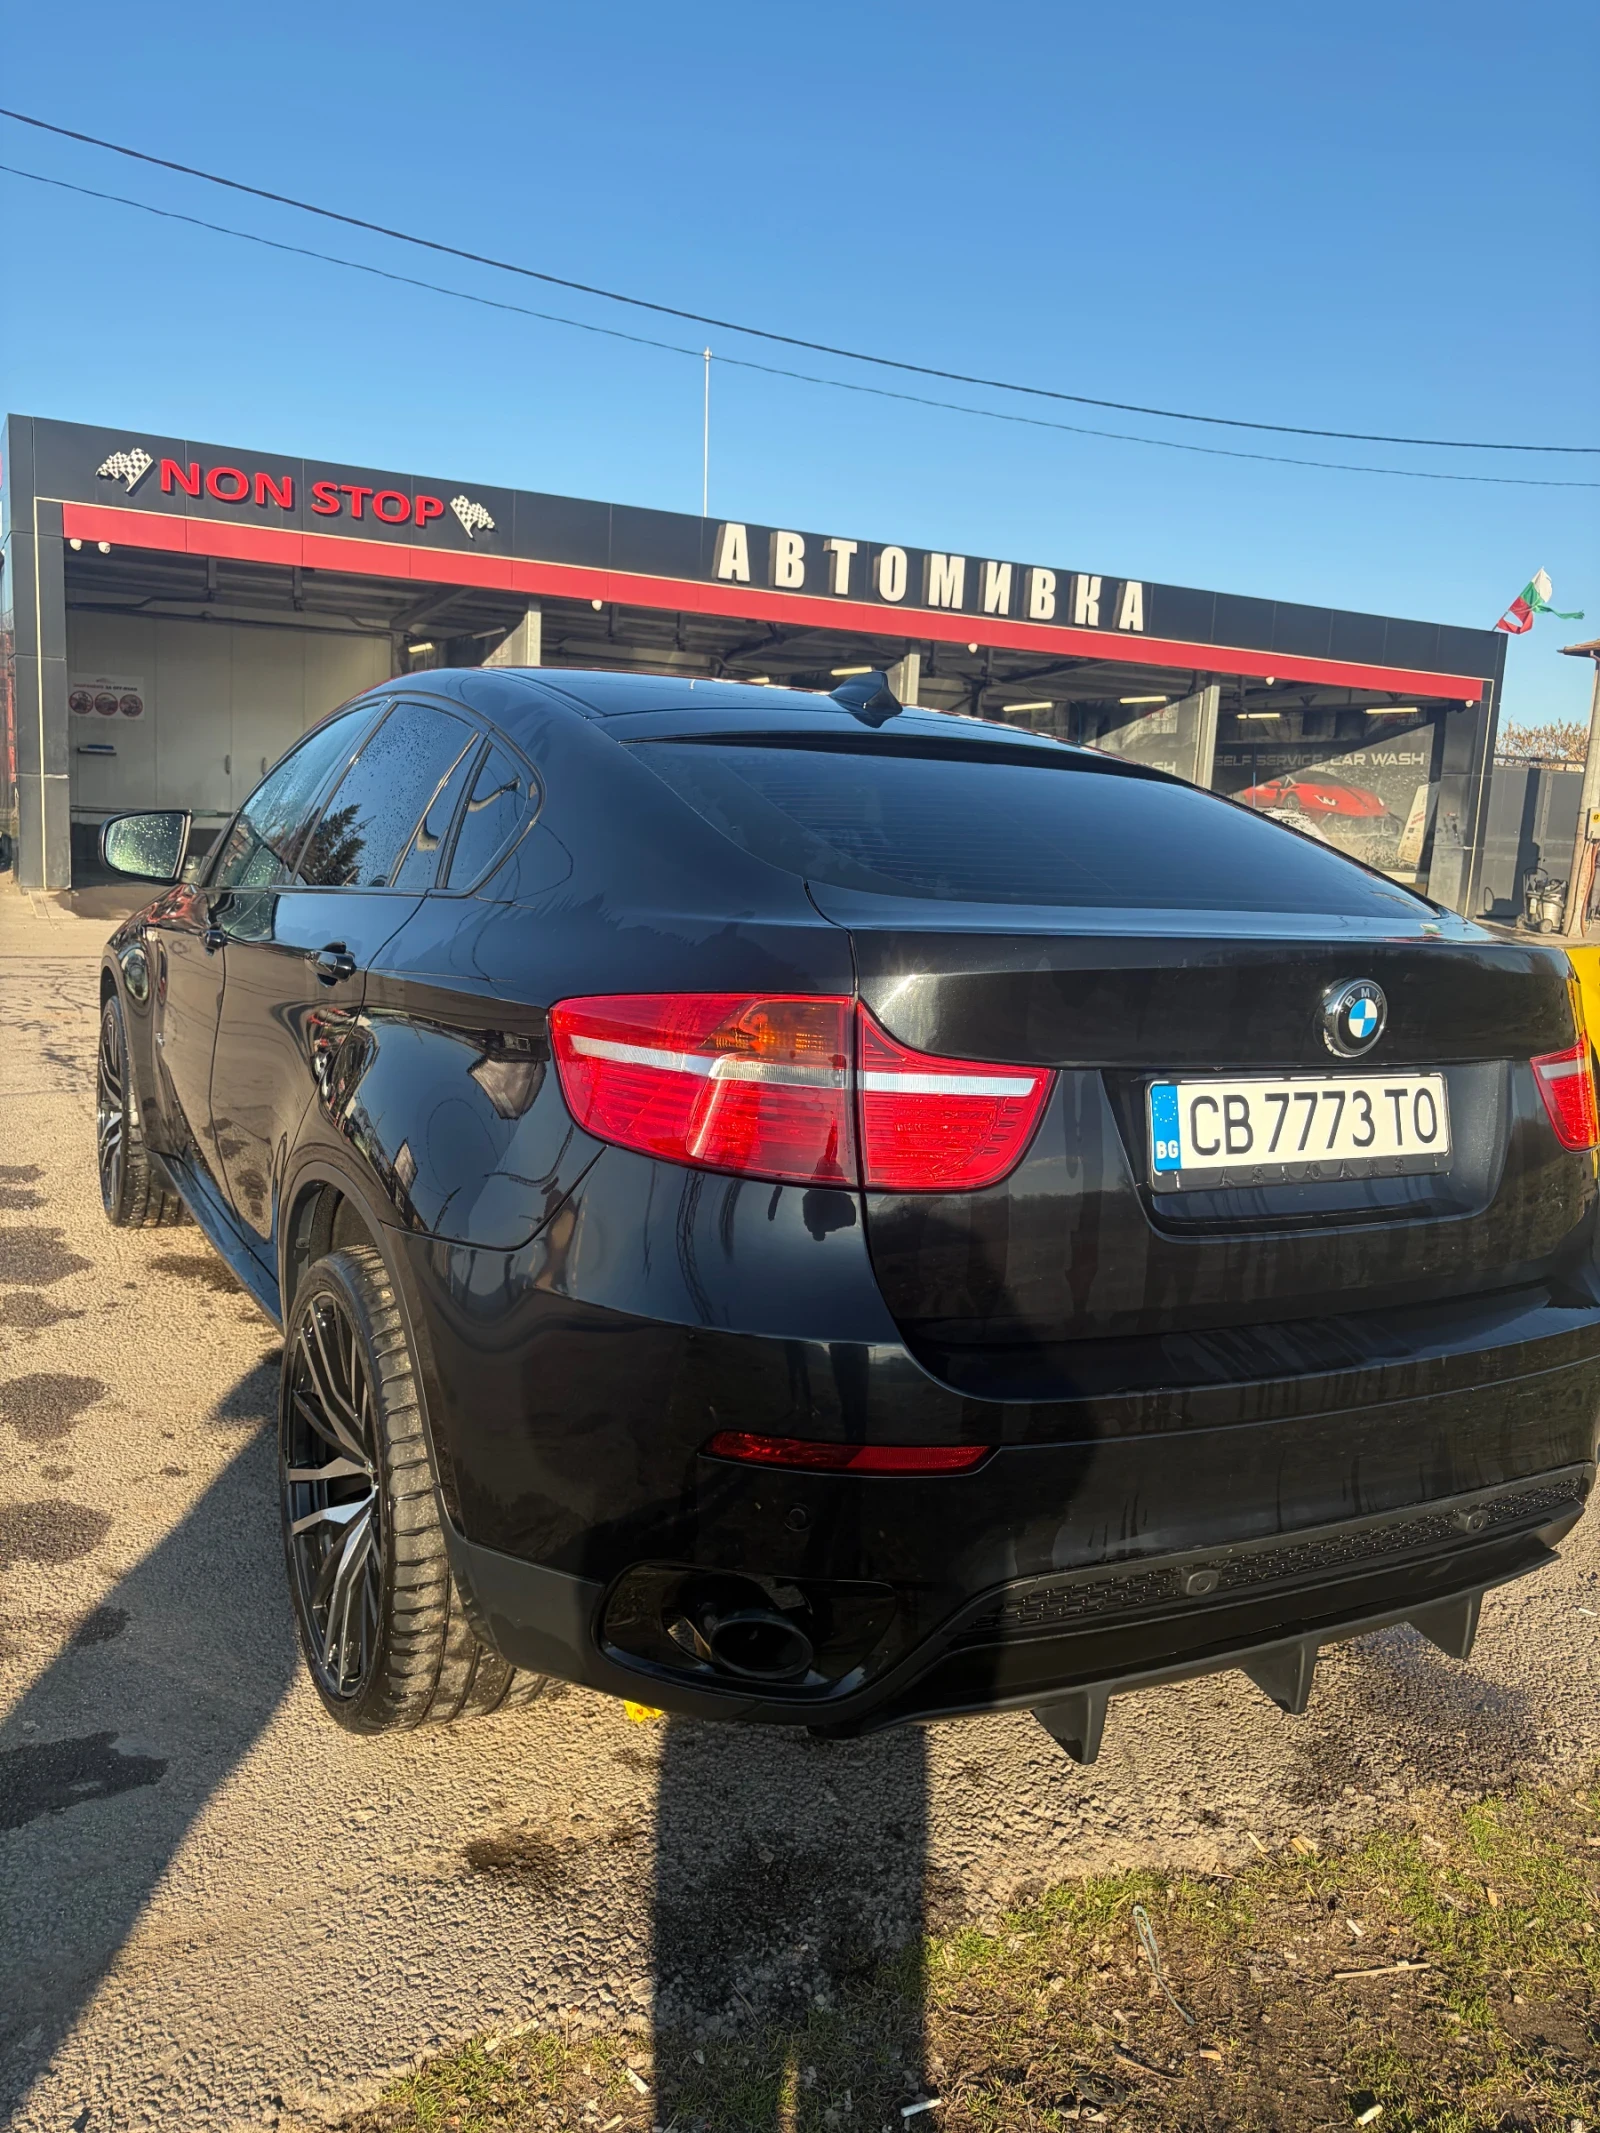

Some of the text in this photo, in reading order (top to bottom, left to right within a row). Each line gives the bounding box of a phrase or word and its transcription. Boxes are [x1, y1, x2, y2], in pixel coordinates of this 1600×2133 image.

[160, 458, 445, 526] NON STOP
[714, 522, 1145, 632] АВТОМИВКА
[1214, 752, 1425, 767] SELF SERVICE CAR WASH
[1344, 987, 1383, 1009] BMW
[1190, 1094, 1254, 1156] CB
[1264, 1090, 1376, 1153] 7773
[1156, 1140, 1179, 1159] BG
